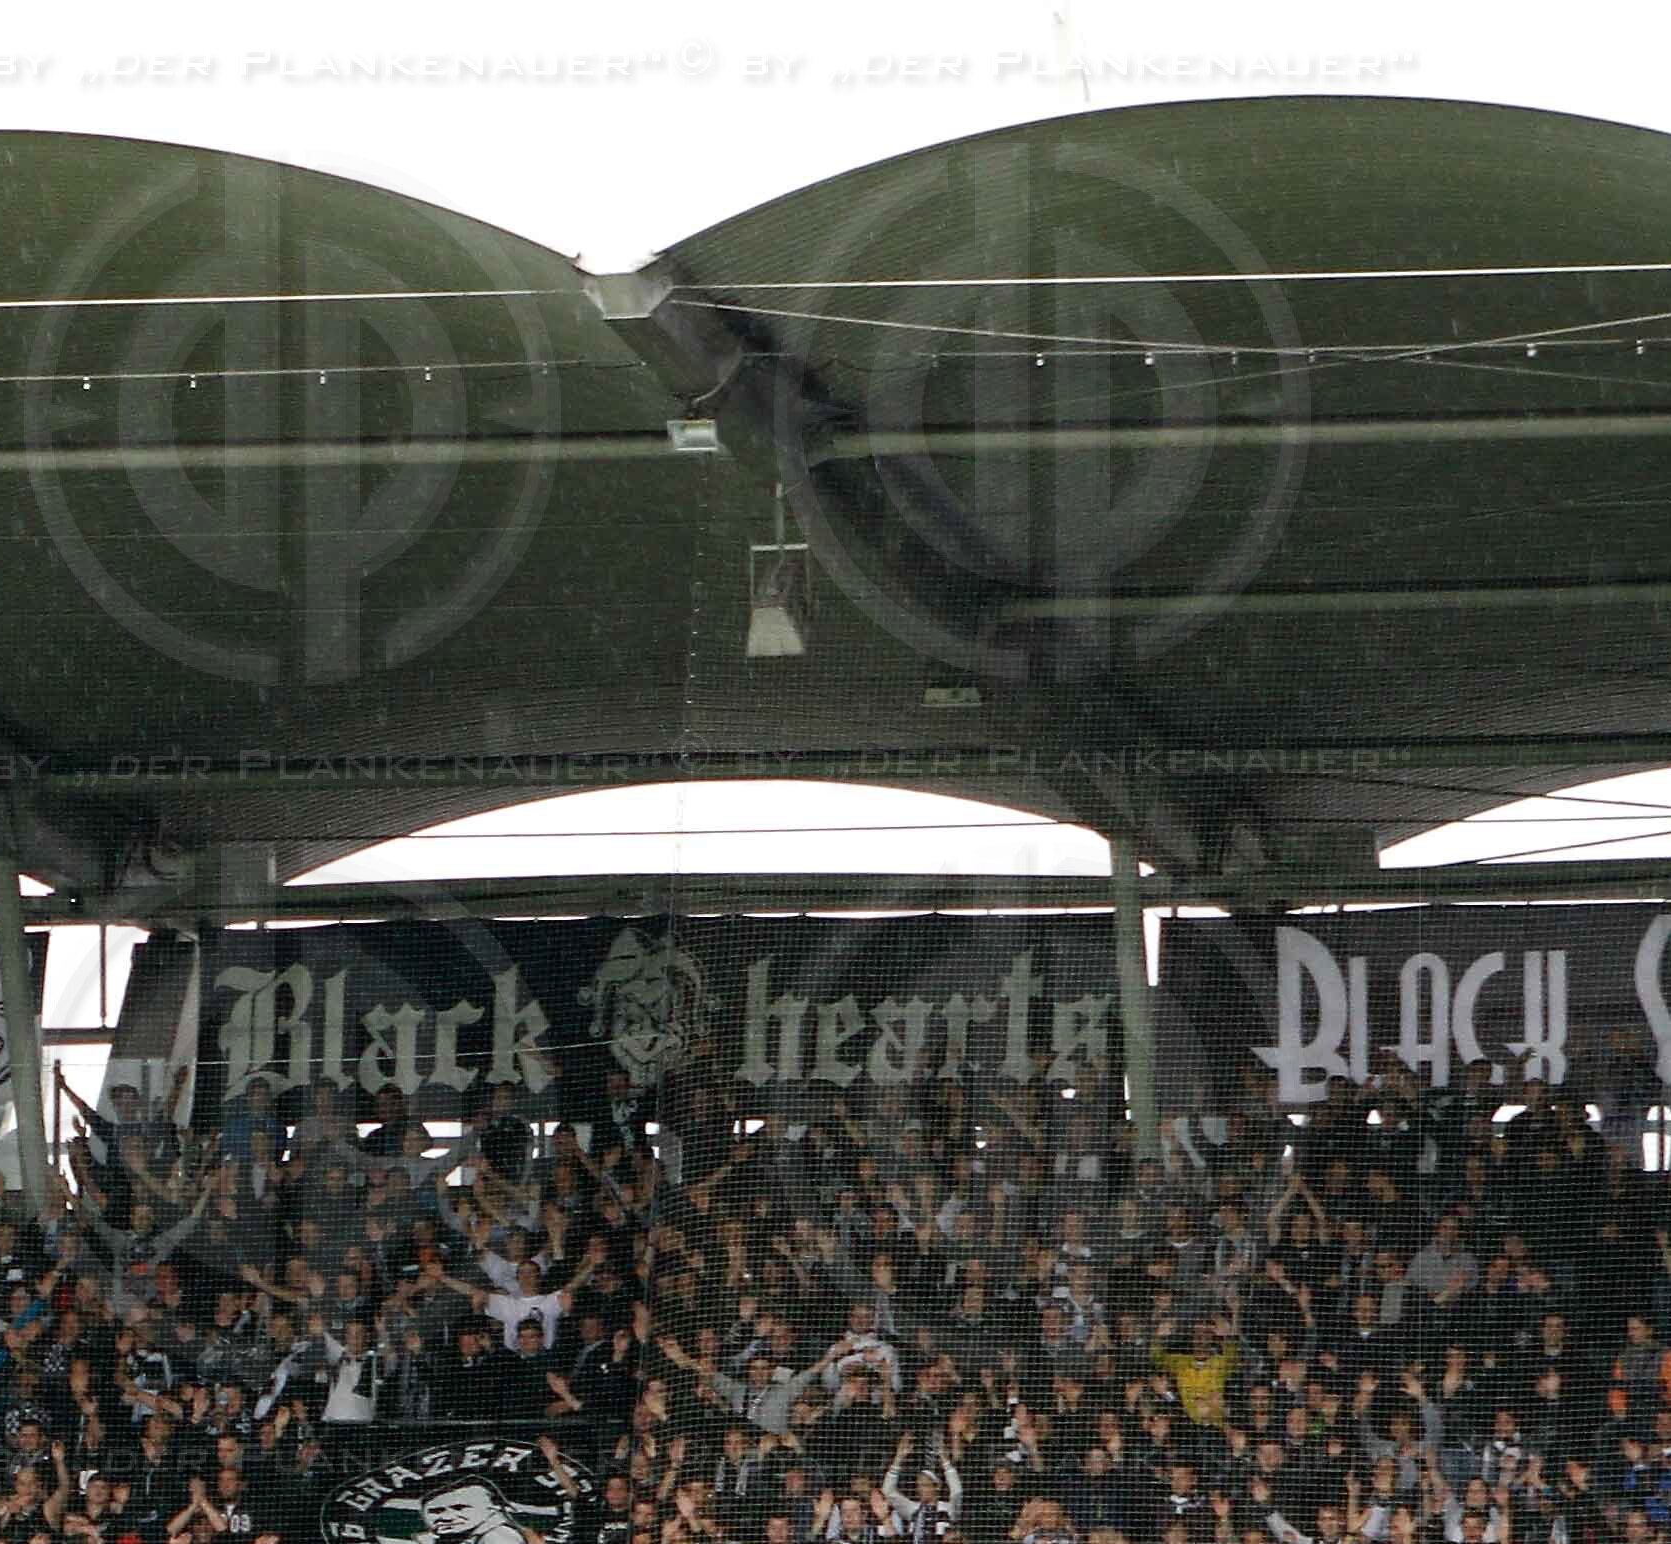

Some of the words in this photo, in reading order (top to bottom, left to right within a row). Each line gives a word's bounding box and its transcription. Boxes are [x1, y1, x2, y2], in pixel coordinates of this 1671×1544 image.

[215, 961, 559, 1101] Black
[736, 947, 1116, 1088] hearts
[1251, 926, 1567, 1103] BLACK
[336, 1444, 533, 1512] GRAZER
